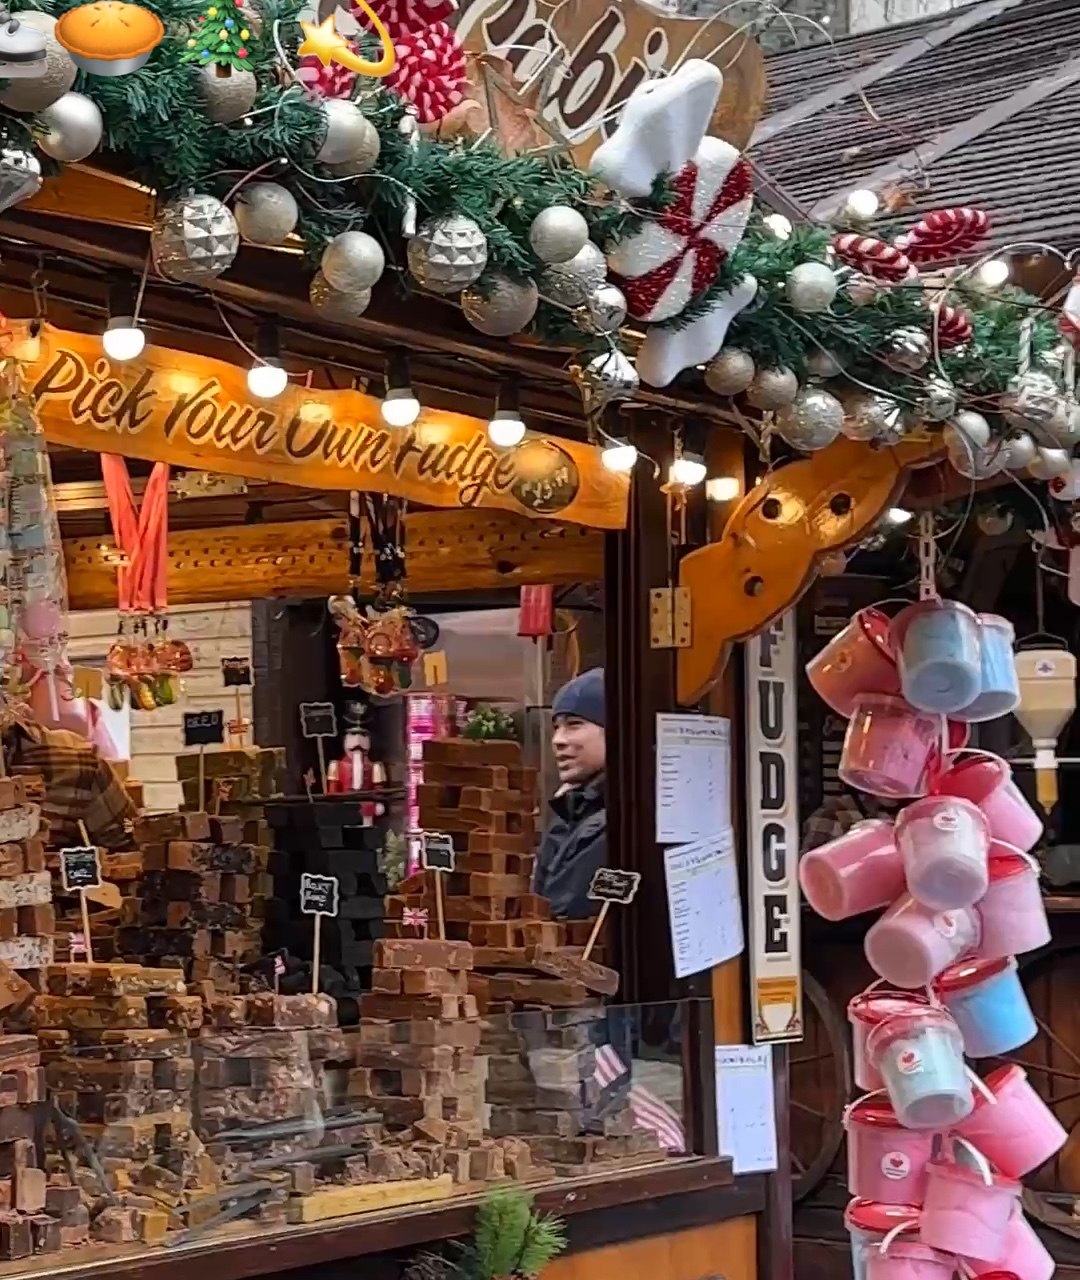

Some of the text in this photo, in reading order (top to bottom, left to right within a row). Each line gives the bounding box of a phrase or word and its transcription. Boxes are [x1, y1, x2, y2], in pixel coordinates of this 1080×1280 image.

[33, 348, 158, 432] Pick
[161, 378, 278, 455] Your
[280, 408, 391, 475] Own
[390, 422, 518, 508] Fudge
[756, 616, 790, 955] FUDGE
